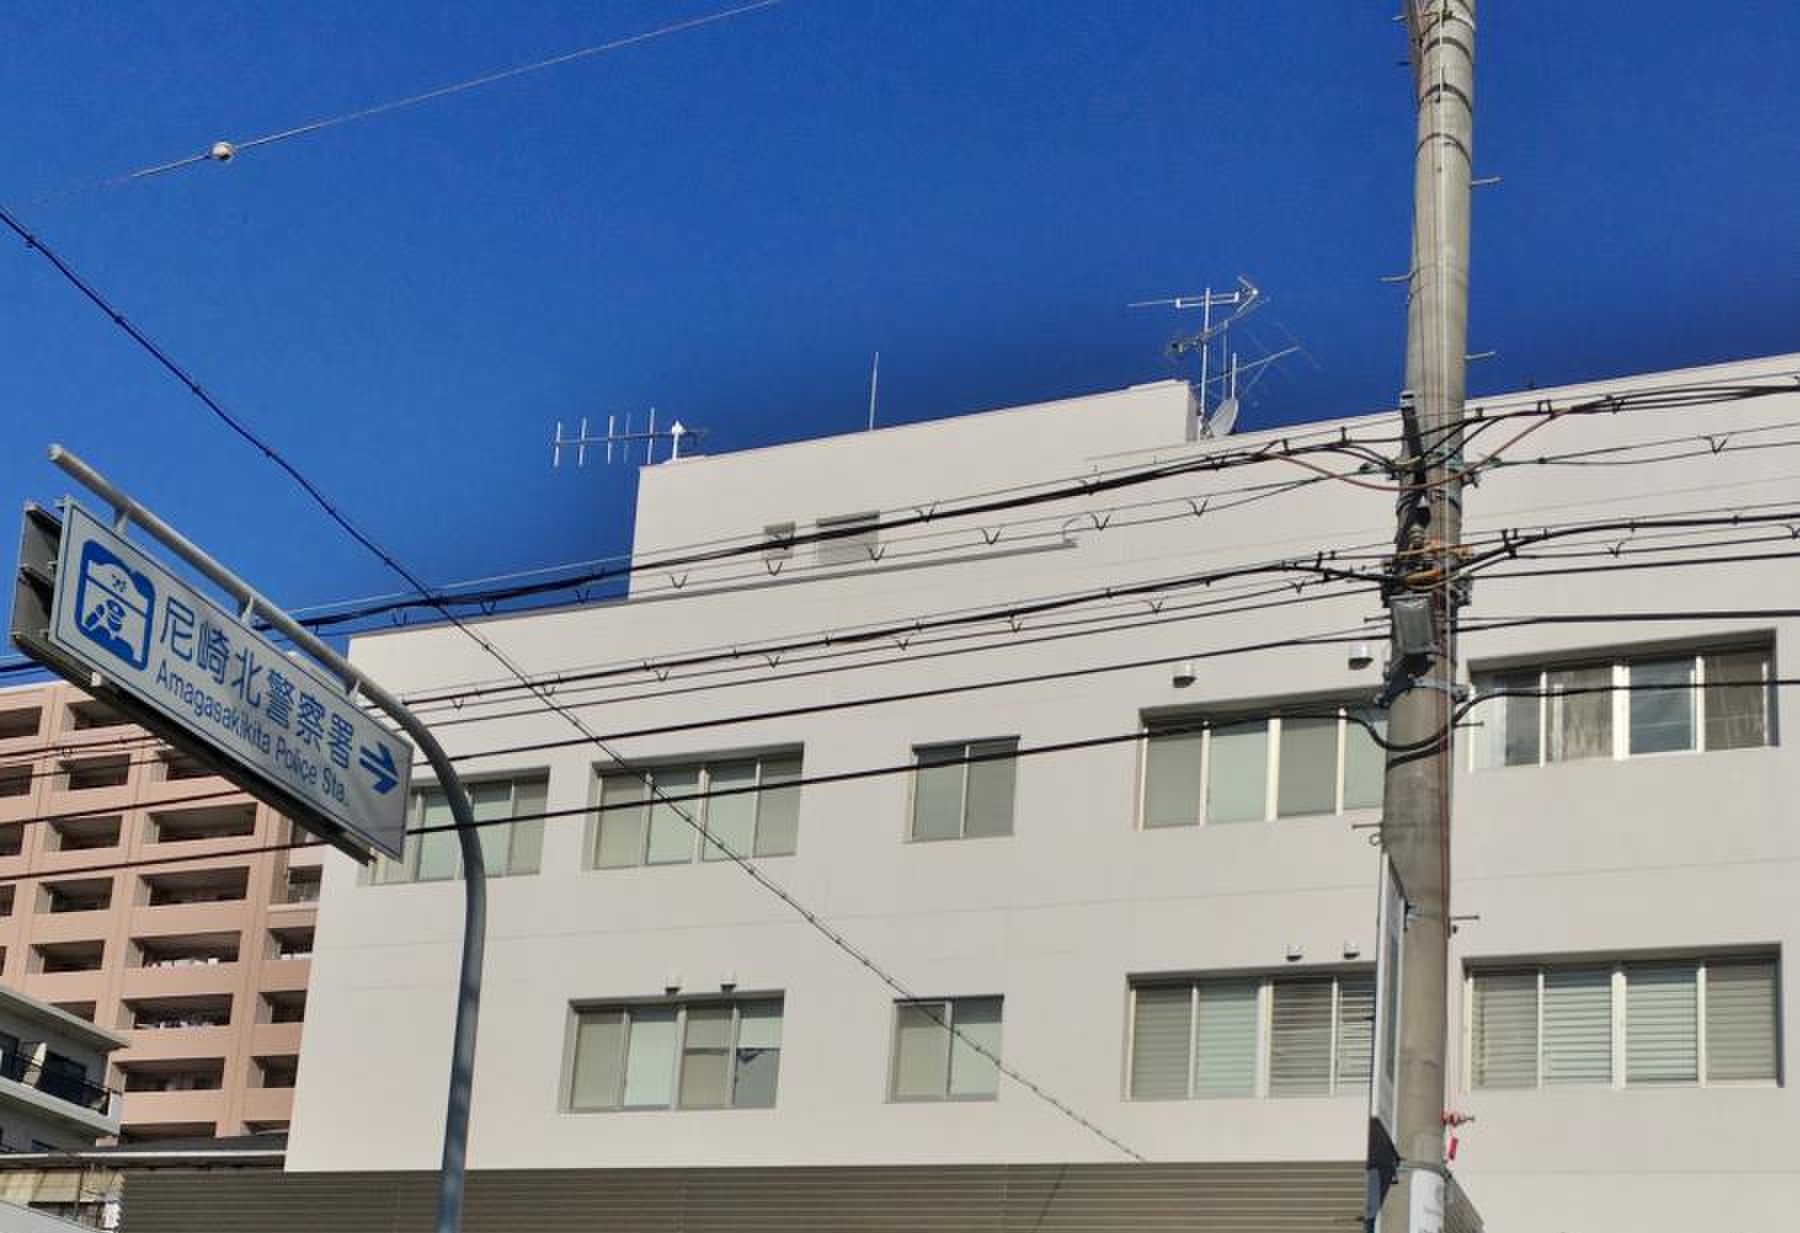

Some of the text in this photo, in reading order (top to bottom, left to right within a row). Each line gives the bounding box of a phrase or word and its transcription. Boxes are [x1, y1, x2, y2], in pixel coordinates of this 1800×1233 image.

[157, 661, 350, 807] Amagasakikita Police Sta.
[161, 597, 353, 769] 尼崎北警察署
